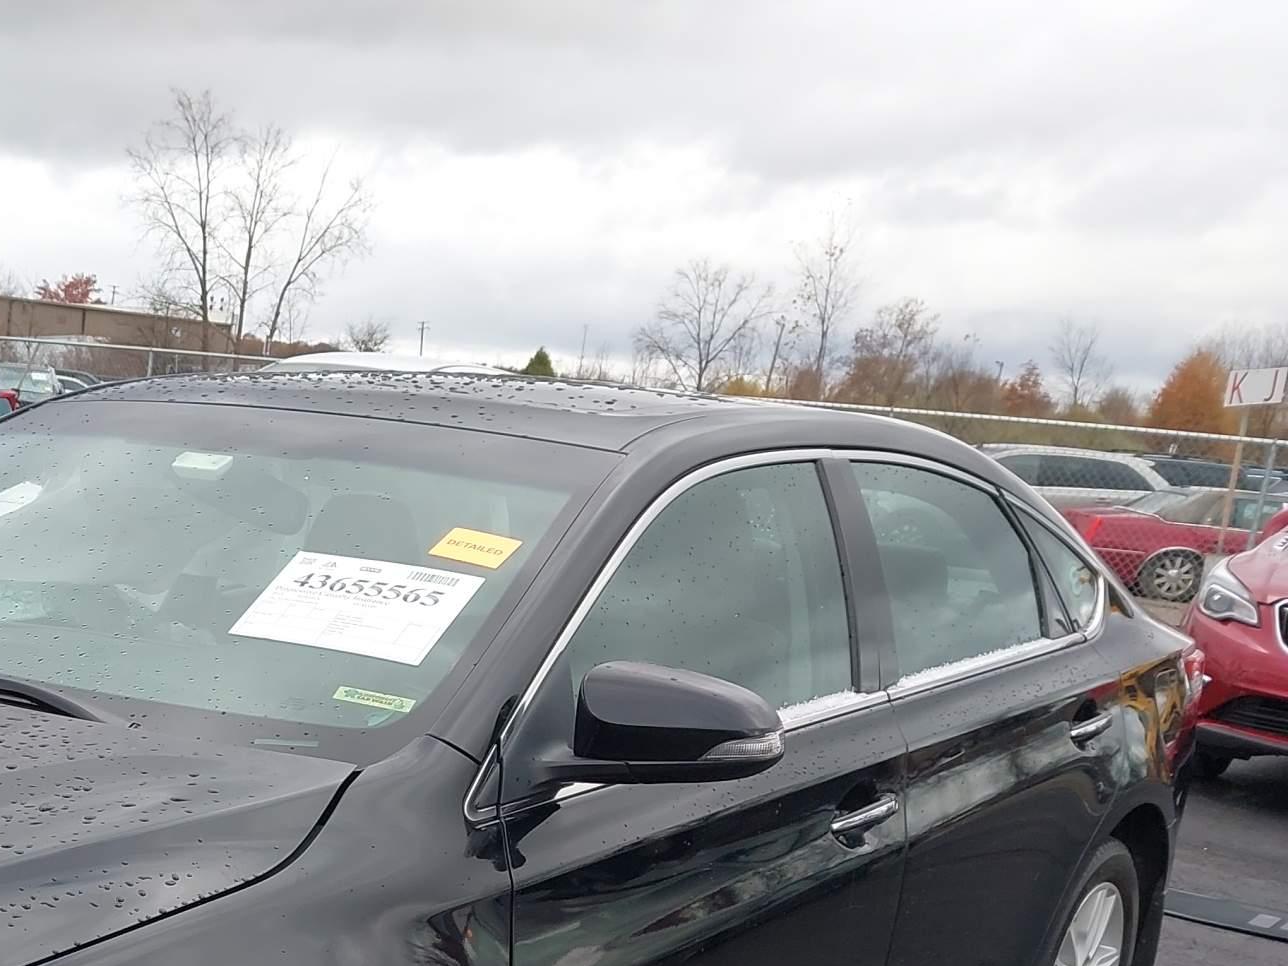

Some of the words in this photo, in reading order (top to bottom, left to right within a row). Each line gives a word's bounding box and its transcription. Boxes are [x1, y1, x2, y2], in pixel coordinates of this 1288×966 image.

[1229, 371, 1249, 405] K
[1263, 370, 1280, 402] J
[446, 539, 503, 556] DETAILED
[293, 573, 445, 607] 43655565
